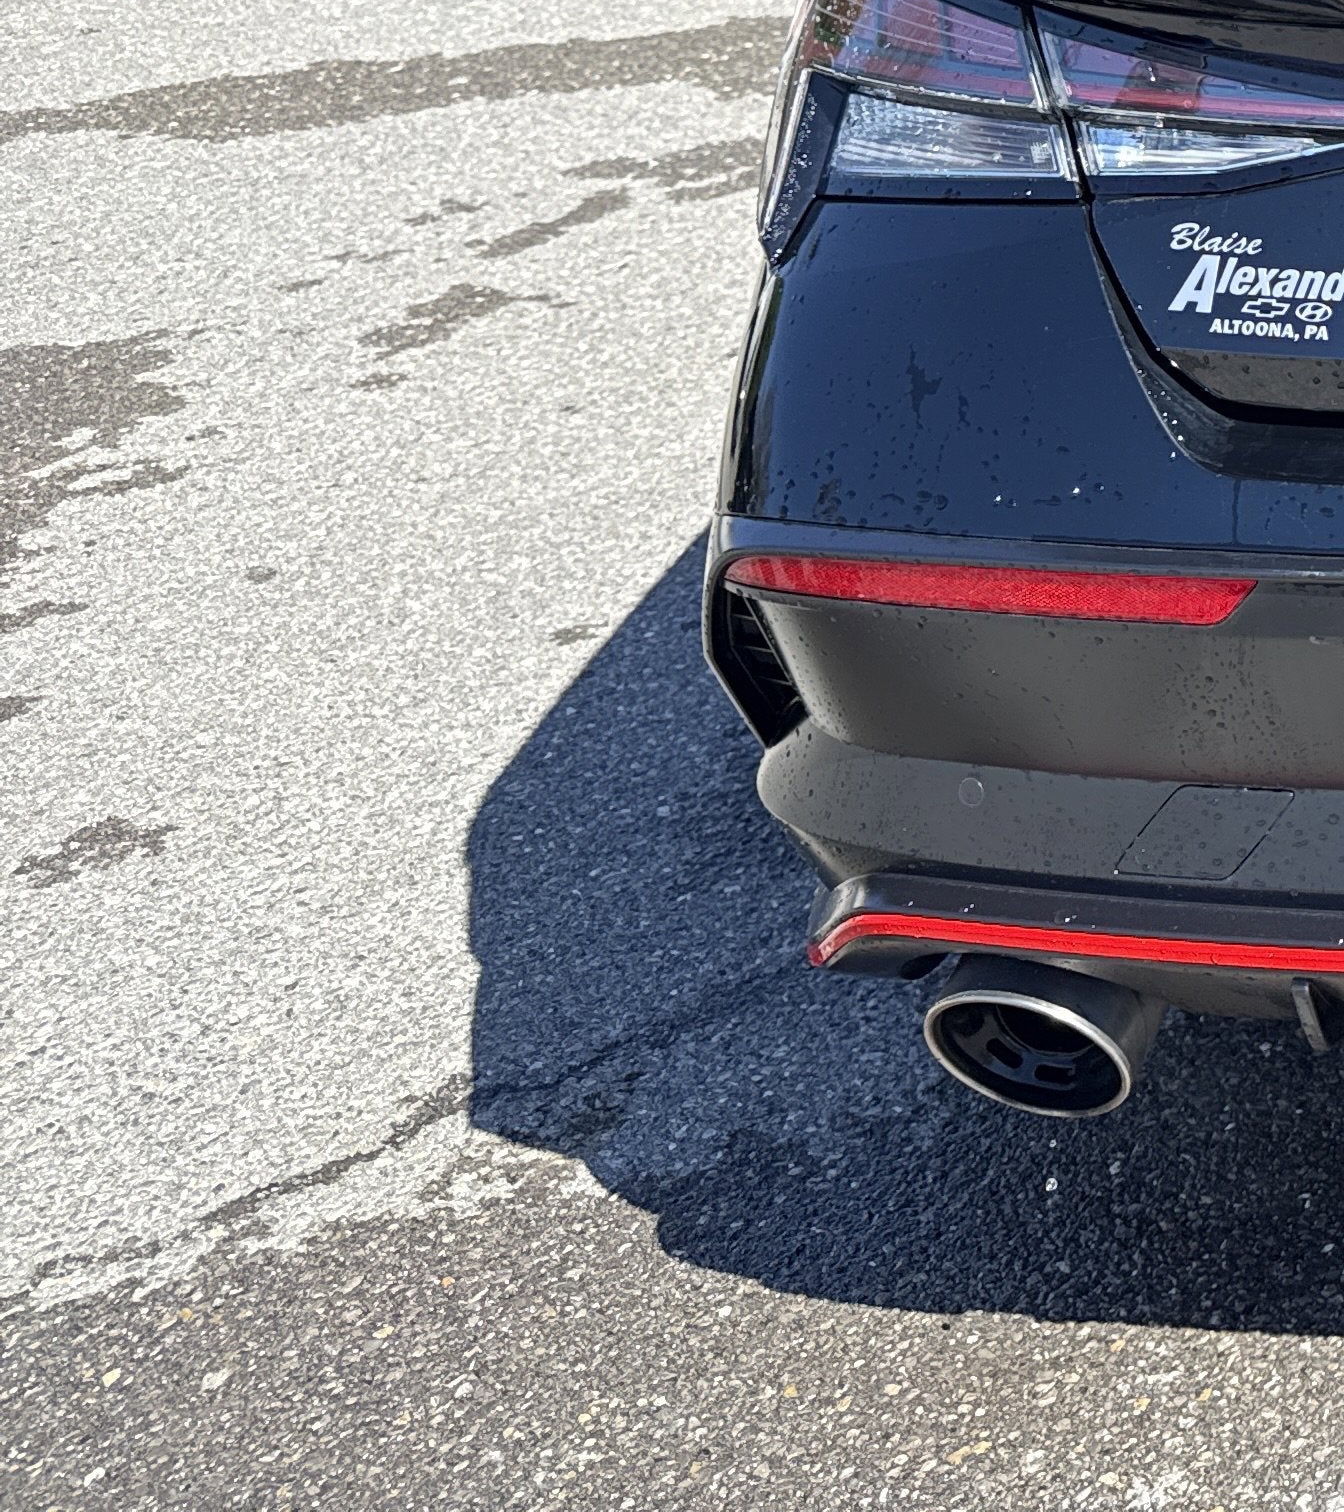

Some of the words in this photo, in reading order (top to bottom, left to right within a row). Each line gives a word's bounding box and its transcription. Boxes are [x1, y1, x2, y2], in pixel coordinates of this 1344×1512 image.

[1169, 222, 1264, 255] Blaise
[1209, 318, 1302, 342] ALTOONA,
[1304, 325, 1330, 341] PA
